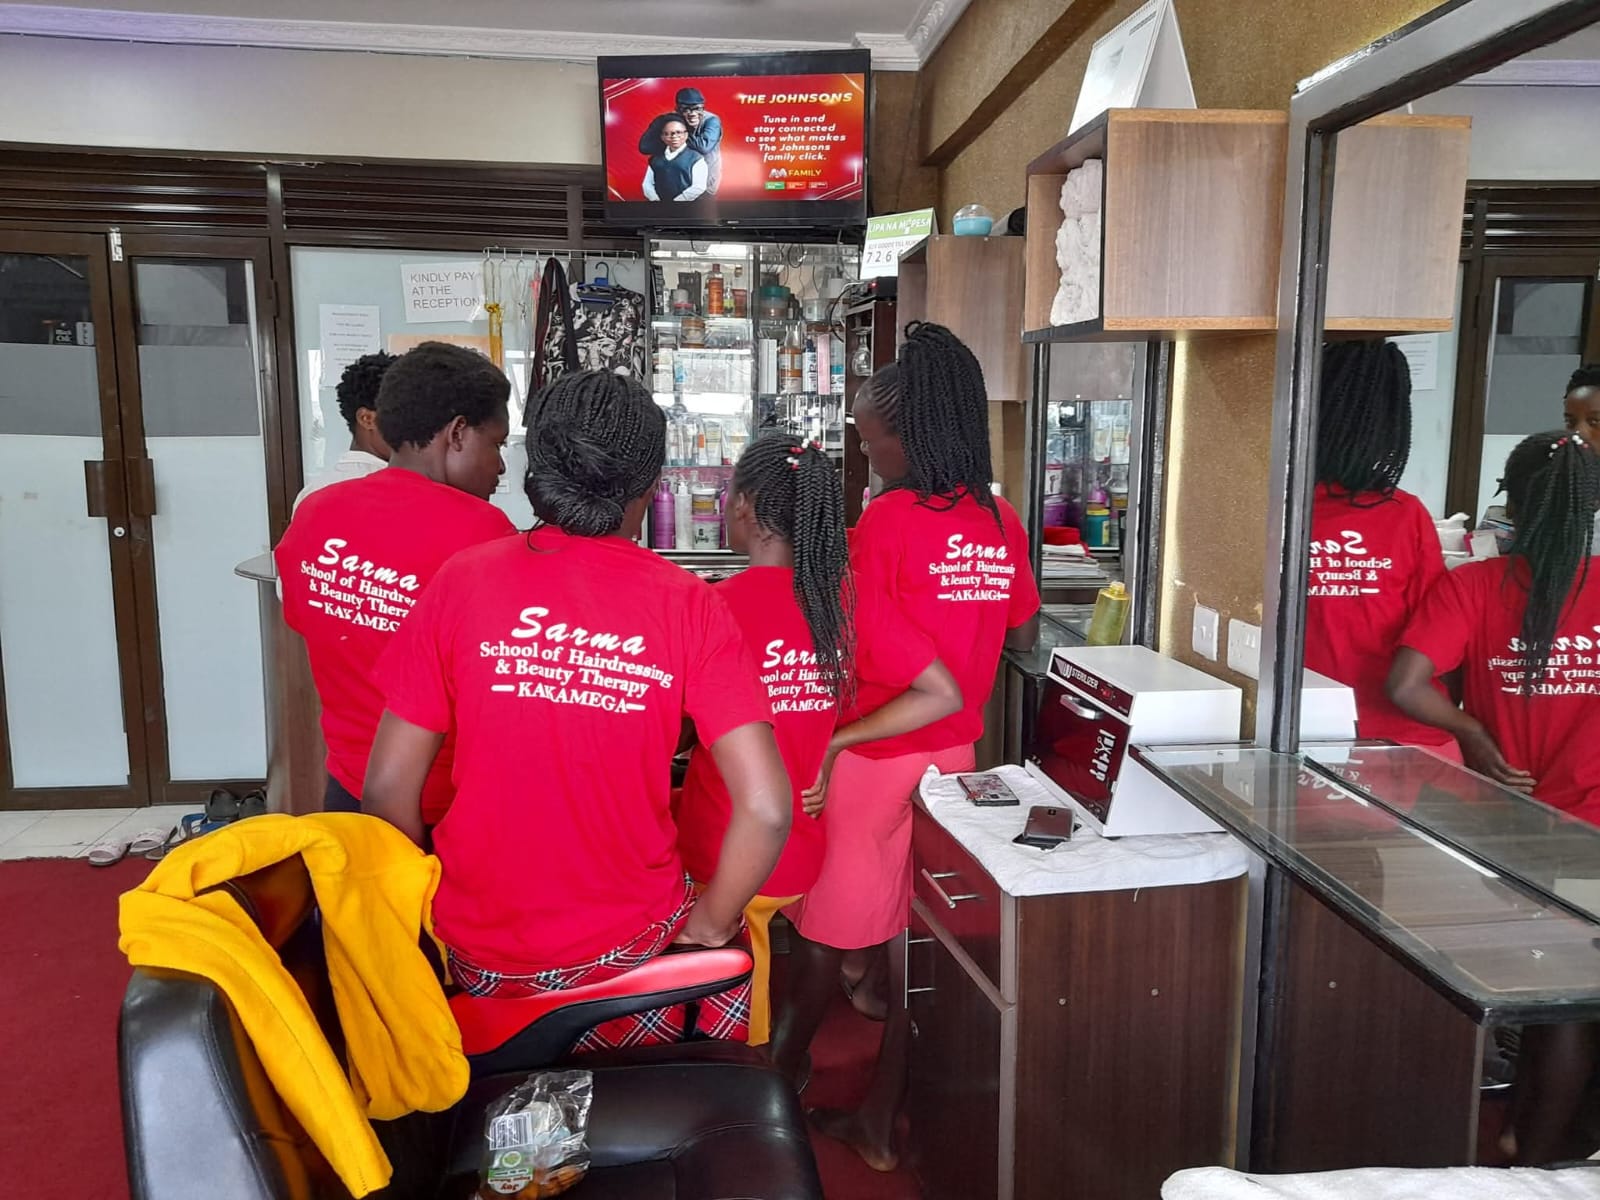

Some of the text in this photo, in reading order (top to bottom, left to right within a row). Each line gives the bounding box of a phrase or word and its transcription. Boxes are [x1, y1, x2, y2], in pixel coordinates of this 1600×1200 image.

[739, 92, 853, 104] THE JOHNSONS
[763, 114, 826, 123] Tune in and
[753, 123, 836, 134] stay connected
[745, 135, 756, 143] to
[779, 133, 805, 142] what
[808, 133, 847, 141] makes
[758, 143, 831, 152] The Johnsons
[763, 152, 827, 163] family click.
[886, 221, 898, 231] NA
[410, 271, 475, 283] KINDLY PAY
[412, 285, 451, 296] AT THE
[413, 297, 480, 309] RECEPTION
[946, 534, 1008, 560] Sarma
[317, 538, 420, 592] Sarma
[929, 561, 961, 575] School
[961, 560, 973, 572] of
[301, 560, 337, 583] School
[339, 576, 356, 589] of
[941, 574, 950, 587] &
[309, 578, 318, 592] &
[320, 581, 365, 610] Beauty
[511, 606, 646, 656] Sarma
[479, 641, 674, 689] School of Hairdressing
[495, 659, 650, 699] & Beauty Therapy
[781, 669, 796, 681] of
[1071, 668, 1100, 690] STERILIZER
[517, 682, 628, 714] KAKAMEGA
